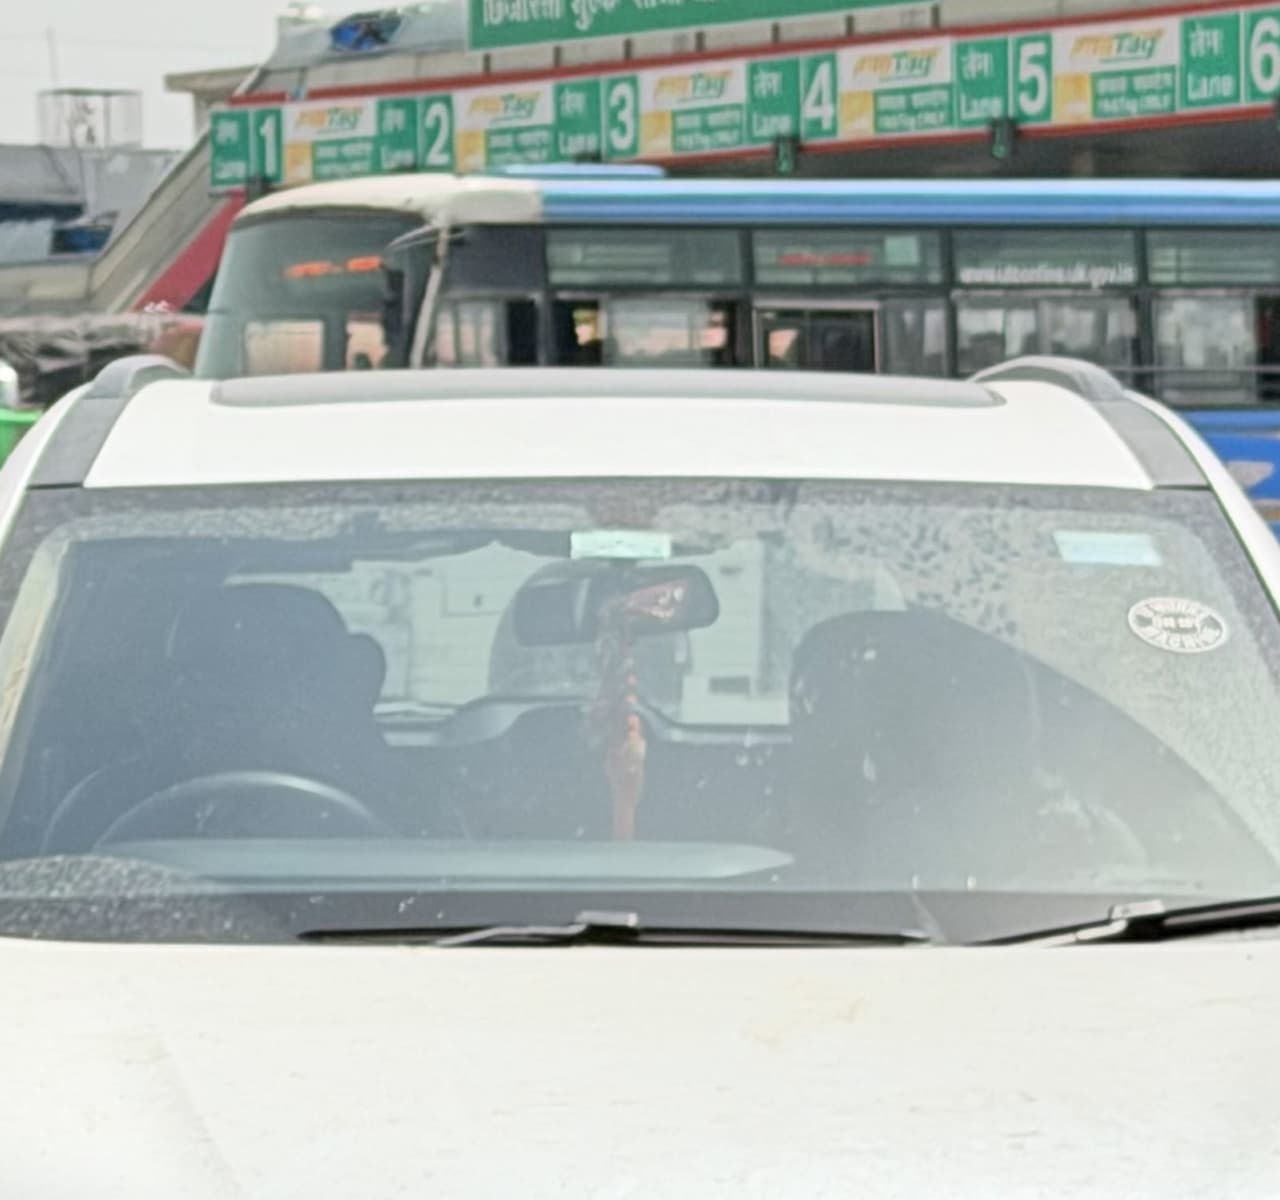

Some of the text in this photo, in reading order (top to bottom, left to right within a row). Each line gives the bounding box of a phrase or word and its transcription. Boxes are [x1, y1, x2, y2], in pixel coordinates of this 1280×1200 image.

[804, 60, 834, 131] 4
[960, 94, 1002, 120] Lane
[1020, 41, 1047, 115] 5
[1187, 72, 1234, 100] Lane
[260, 116, 276, 177] 1
[425, 103, 450, 165] 2
[610, 82, 634, 150] 3
